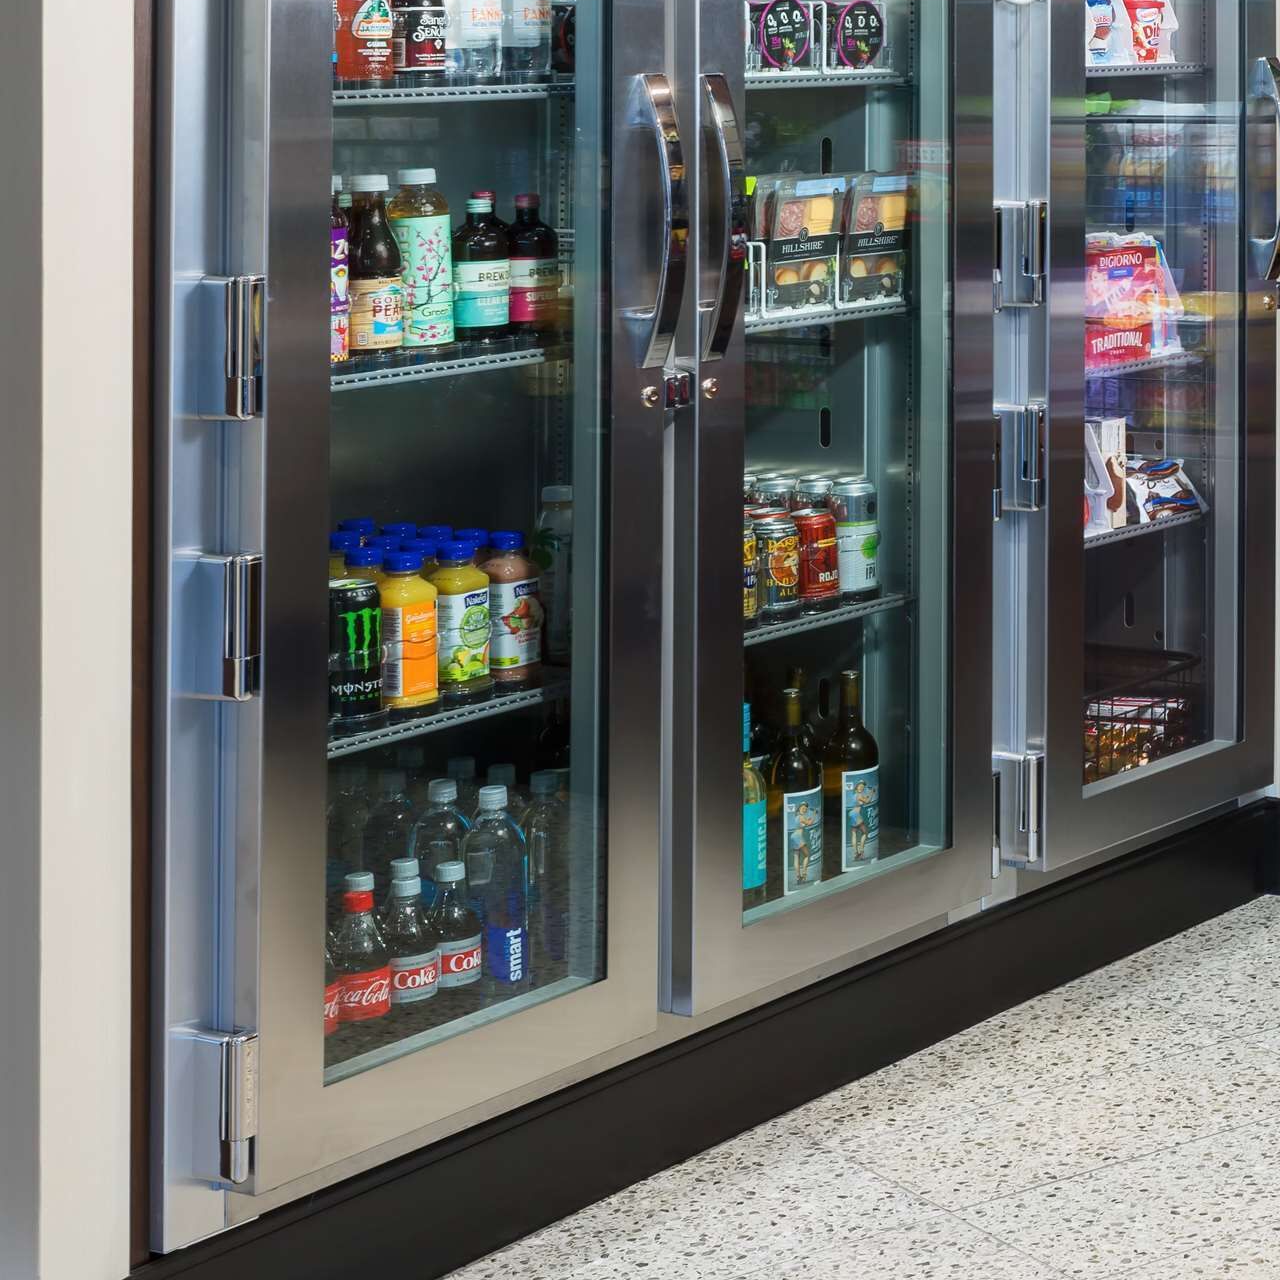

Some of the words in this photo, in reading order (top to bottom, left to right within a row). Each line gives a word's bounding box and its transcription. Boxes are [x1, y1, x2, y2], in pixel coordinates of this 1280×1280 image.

[782, 240, 825, 254] HILLSHIRE
[857, 235, 898, 248] HILLSHIRE
[421, 307, 449, 318] Green
[1091, 331, 1143, 354] TRADITIONAL
[331, 679, 384, 695] MONSTE
[505, 927, 523, 982] smart
[394, 968, 437, 991] Coke
